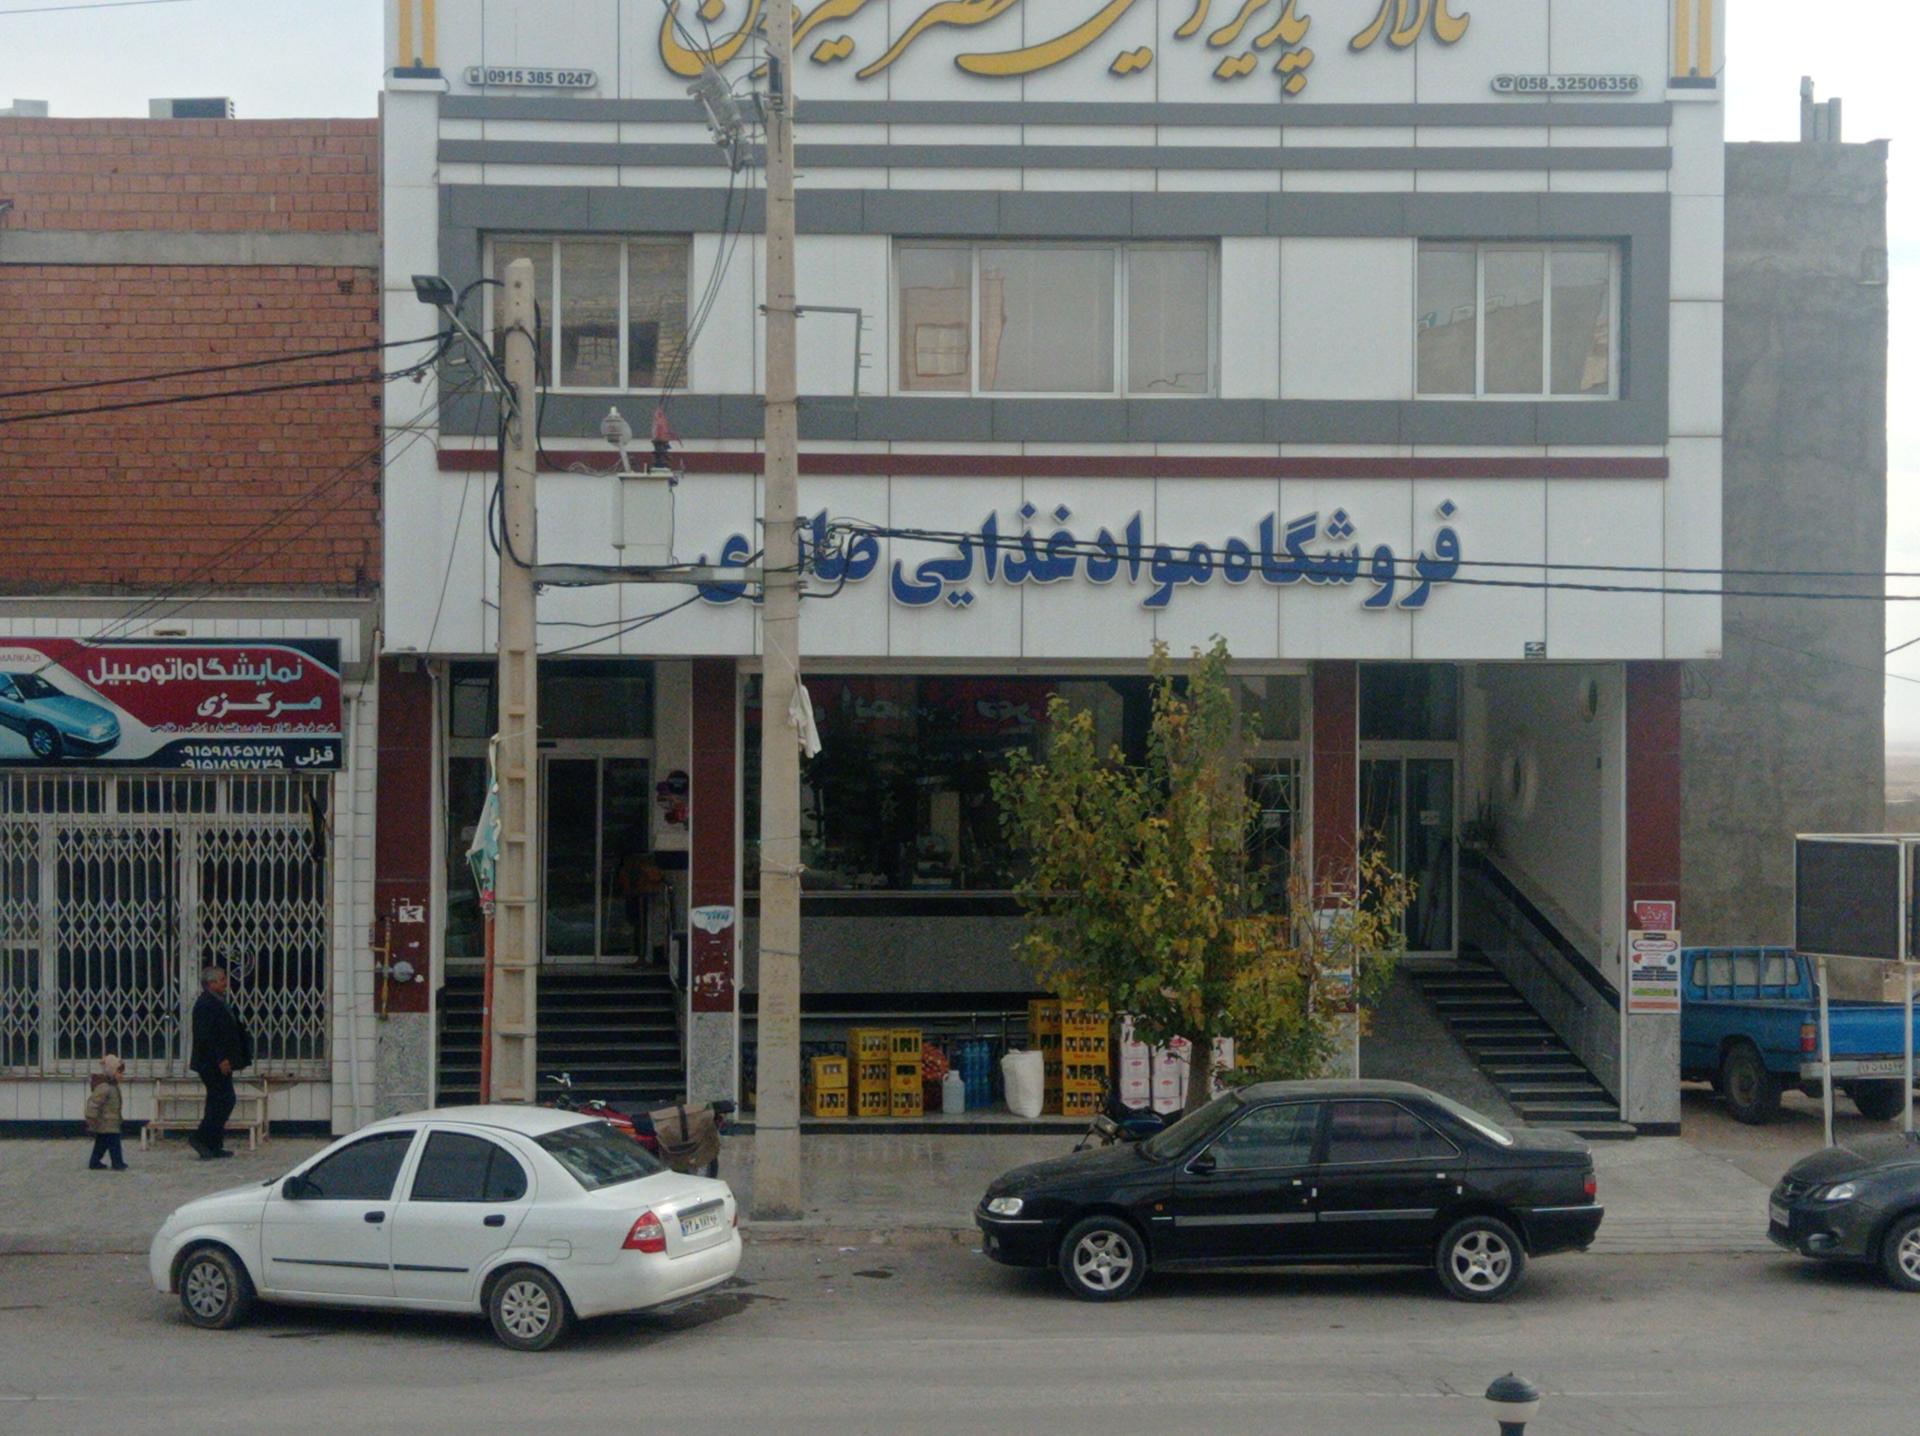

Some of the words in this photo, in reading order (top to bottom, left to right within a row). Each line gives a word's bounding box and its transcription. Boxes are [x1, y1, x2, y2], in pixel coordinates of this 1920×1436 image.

[488, 70, 523, 82] 0915
[527, 71, 553, 84] 385
[557, 72, 593, 85] 0247
[1518, 77, 1639, 90] 058.32506356
[889, 500, 1078, 607] غذایی
[1085, 508, 1214, 610] مواد
[1223, 498, 1461, 609] فروشگاه
[87, 656, 183, 686] اتومبیل
[183, 652, 303, 687] نمایشگاه
[196, 692, 323, 718] مرکزی
[294, 745, 335, 766] قزلی
